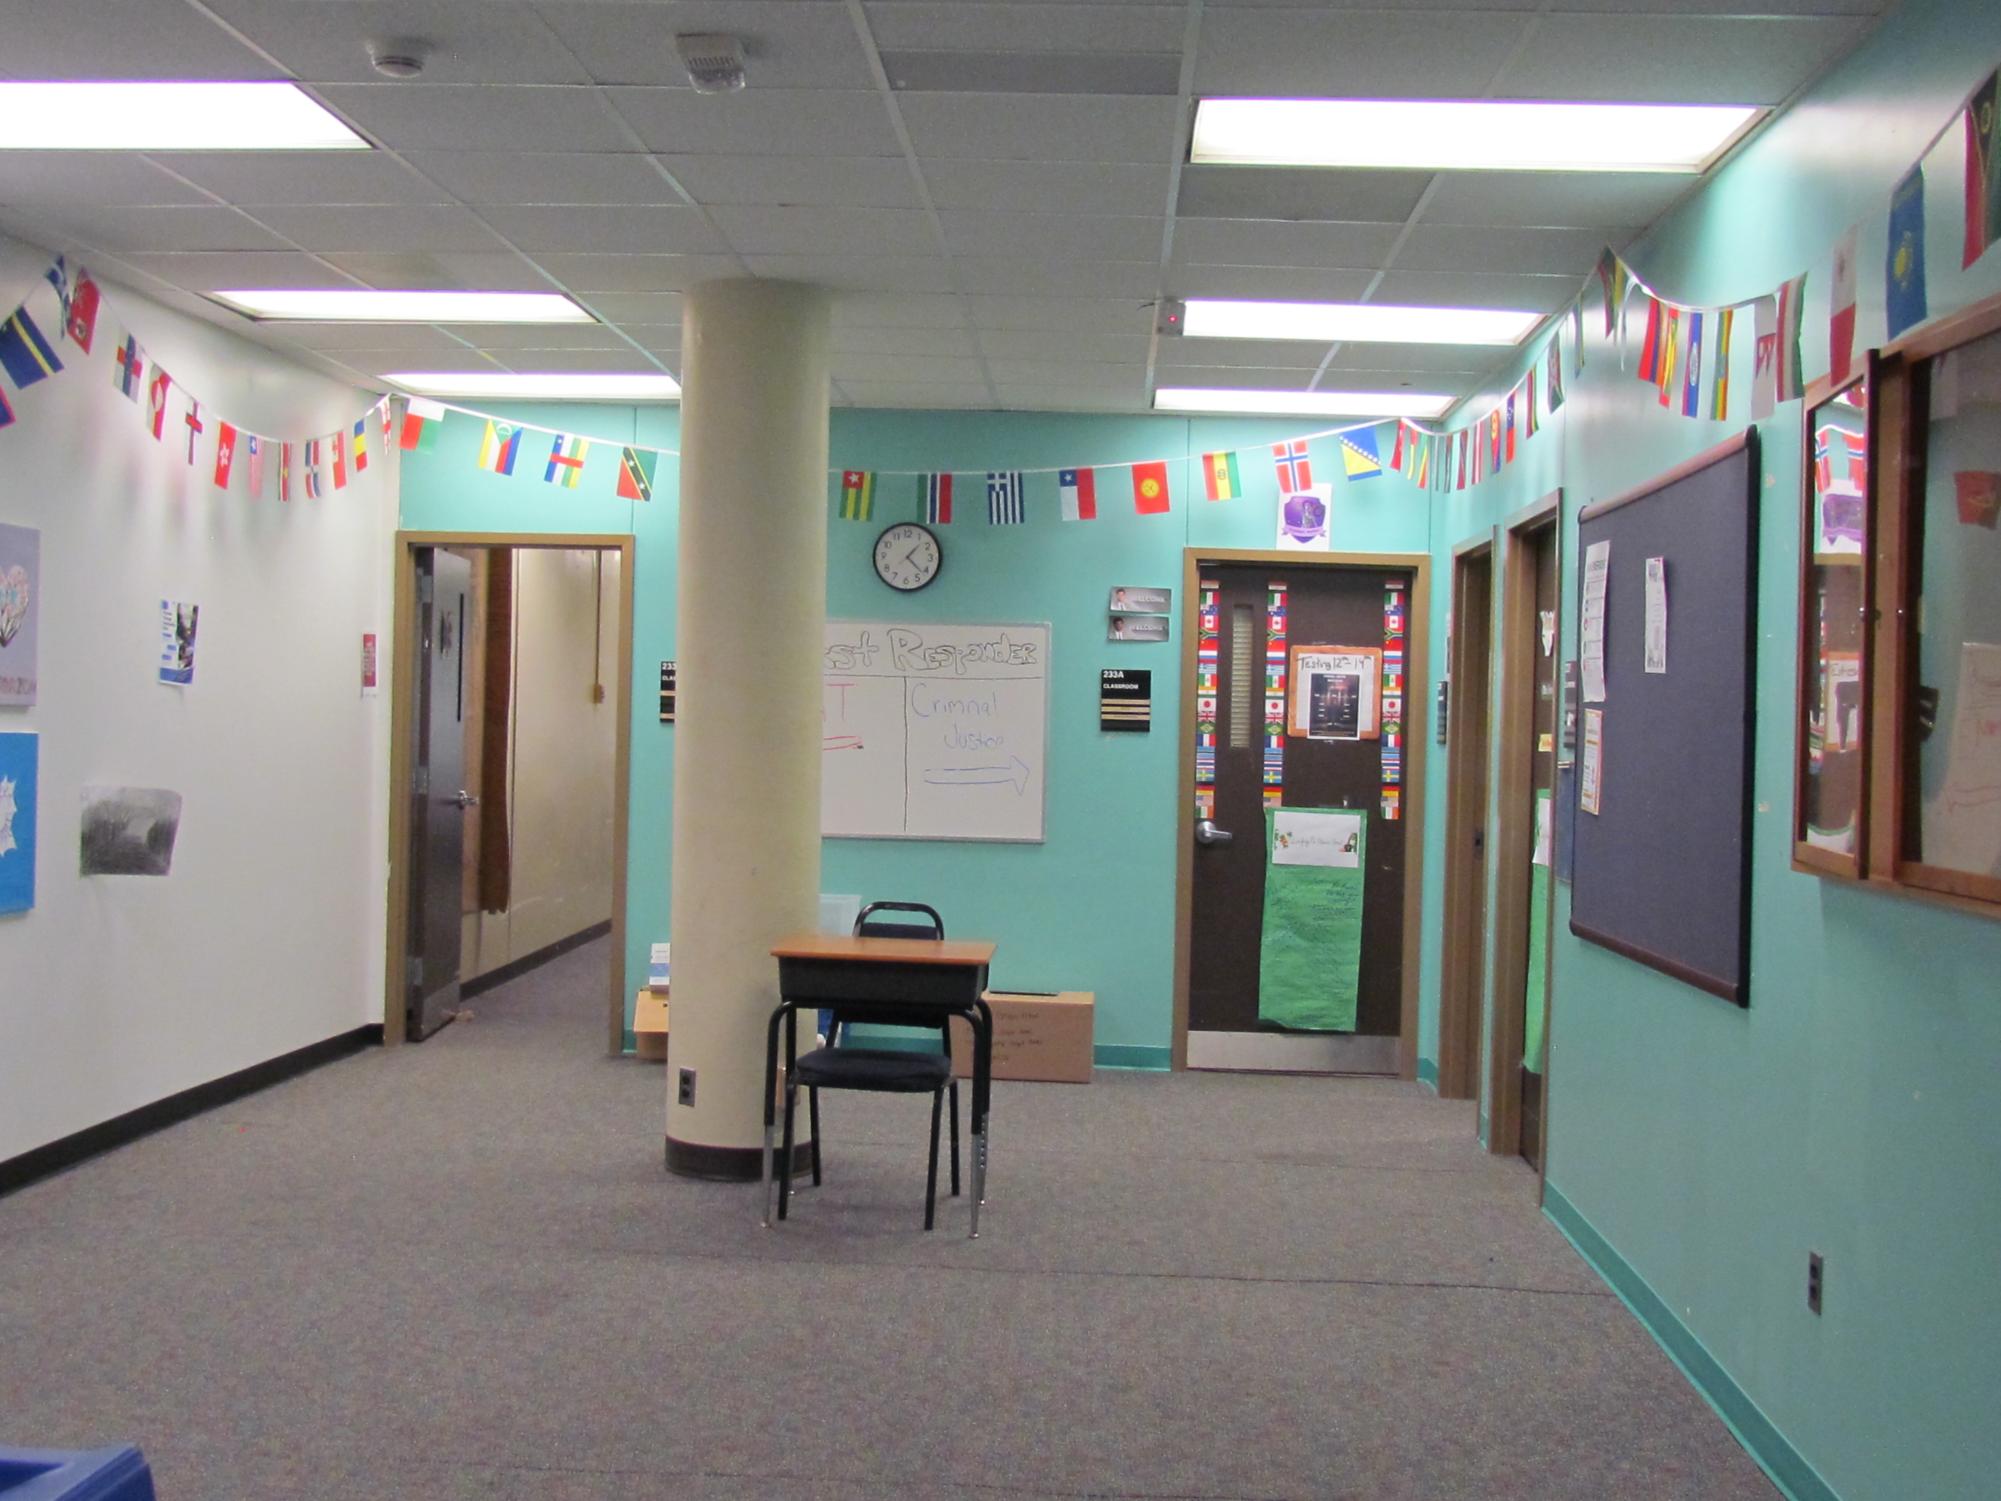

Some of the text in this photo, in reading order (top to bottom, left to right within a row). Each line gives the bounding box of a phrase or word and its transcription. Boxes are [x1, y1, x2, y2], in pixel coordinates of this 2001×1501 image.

[903, 529, 912, 538] 12
[925, 542, 930, 551] 2
[927, 553, 934, 562] 3
[903, 577, 909, 585] 6
[914, 573, 921, 582] 5
[1103, 670, 1124, 678] 233A
